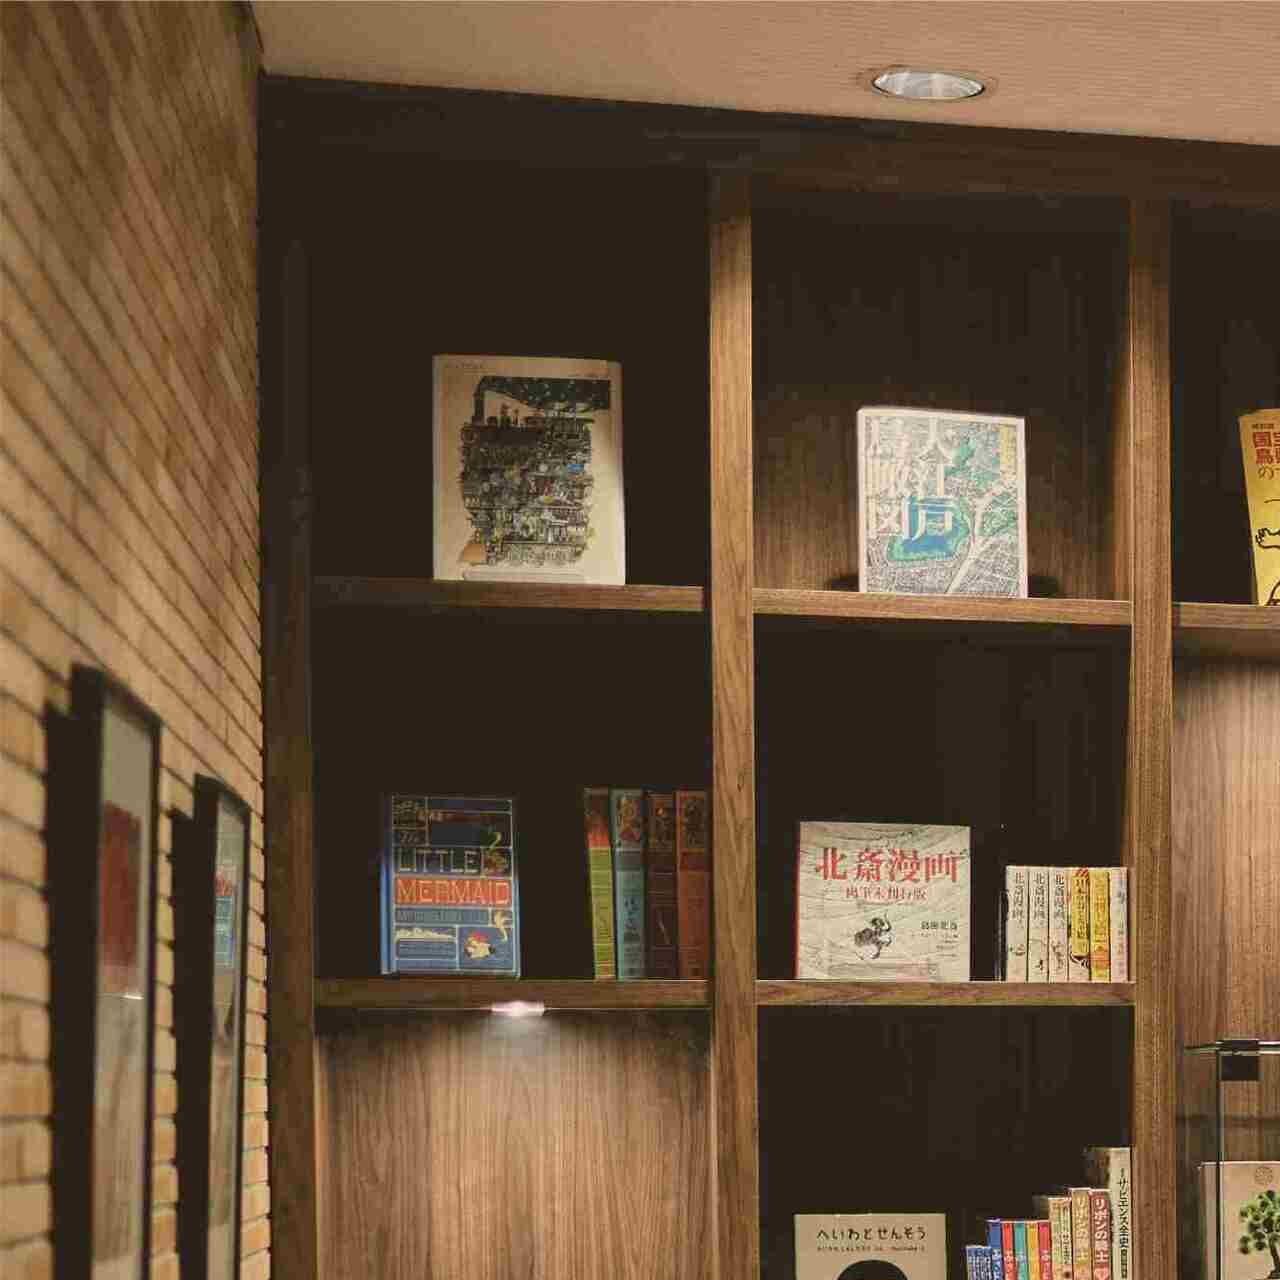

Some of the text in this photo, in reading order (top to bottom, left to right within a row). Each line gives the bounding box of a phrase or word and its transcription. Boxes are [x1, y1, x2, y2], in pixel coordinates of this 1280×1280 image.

[399, 850, 479, 873] LITTLE
[399, 880, 510, 904] MERMAID
[817, 1226, 926, 1241] へいわとせんそう
